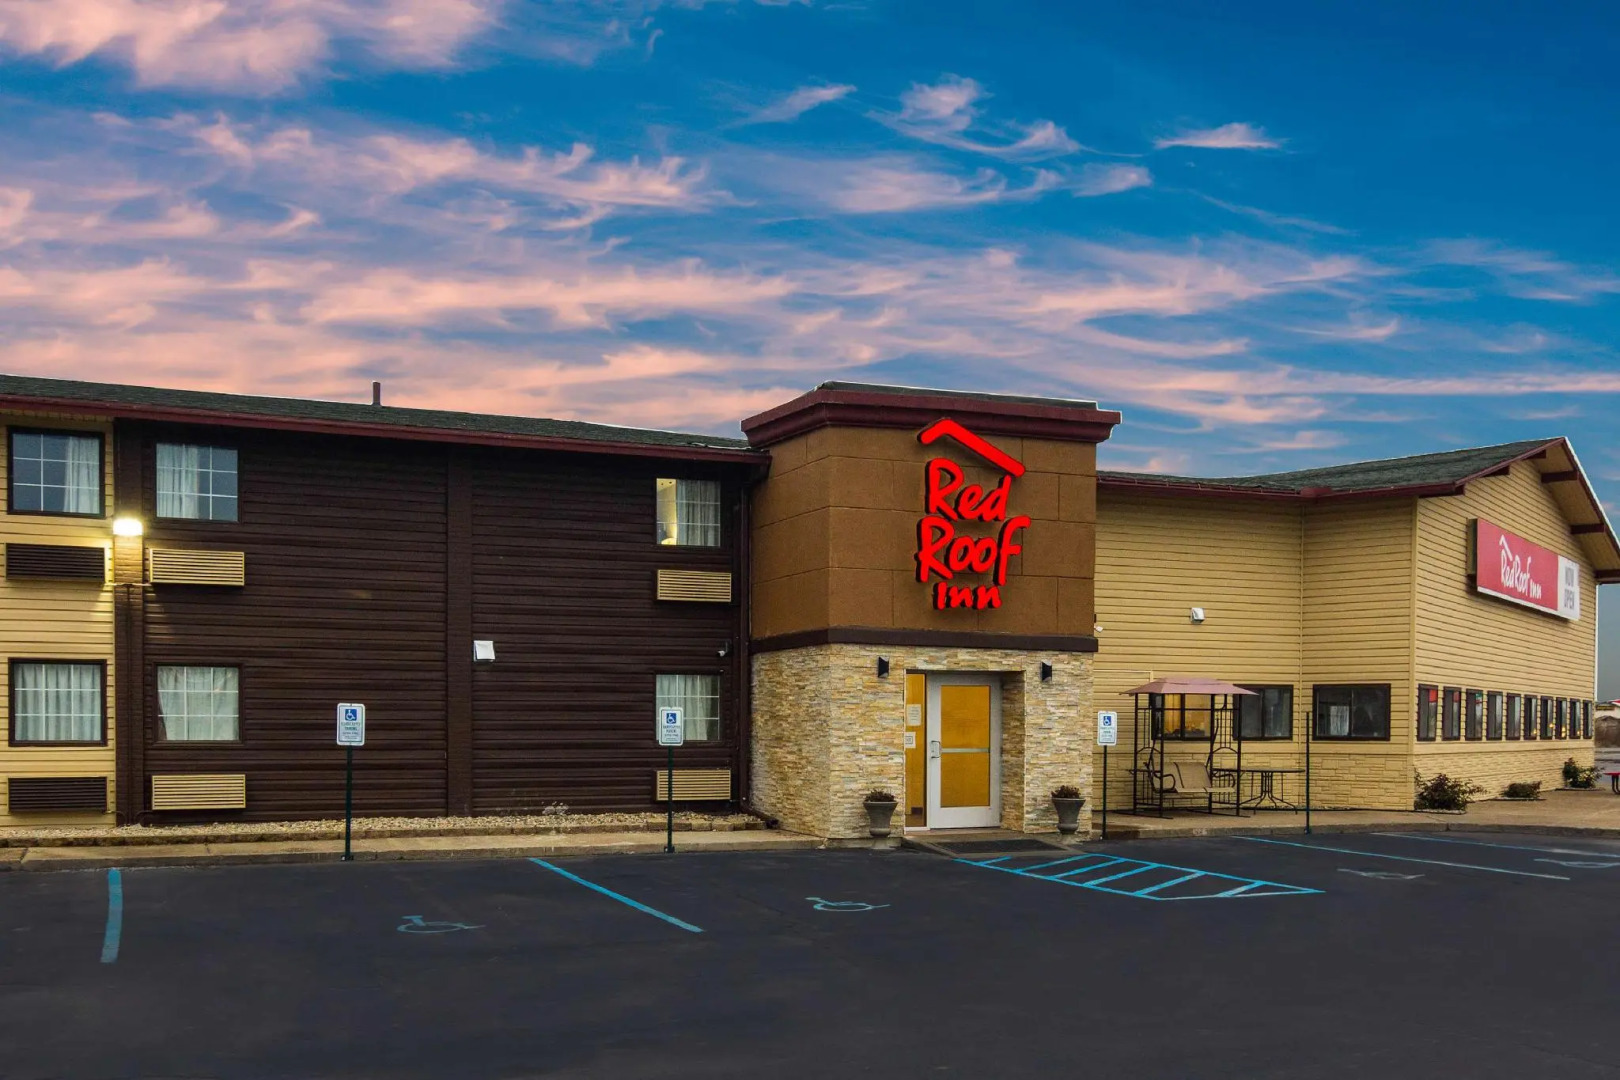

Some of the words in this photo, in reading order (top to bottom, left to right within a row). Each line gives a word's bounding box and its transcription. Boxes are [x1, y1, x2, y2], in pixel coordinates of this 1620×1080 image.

[925, 458, 1012, 522] Red
[914, 515, 1031, 585] Roof
[1501, 549, 1514, 588] Red
[1514, 555, 1531, 596] Roof
